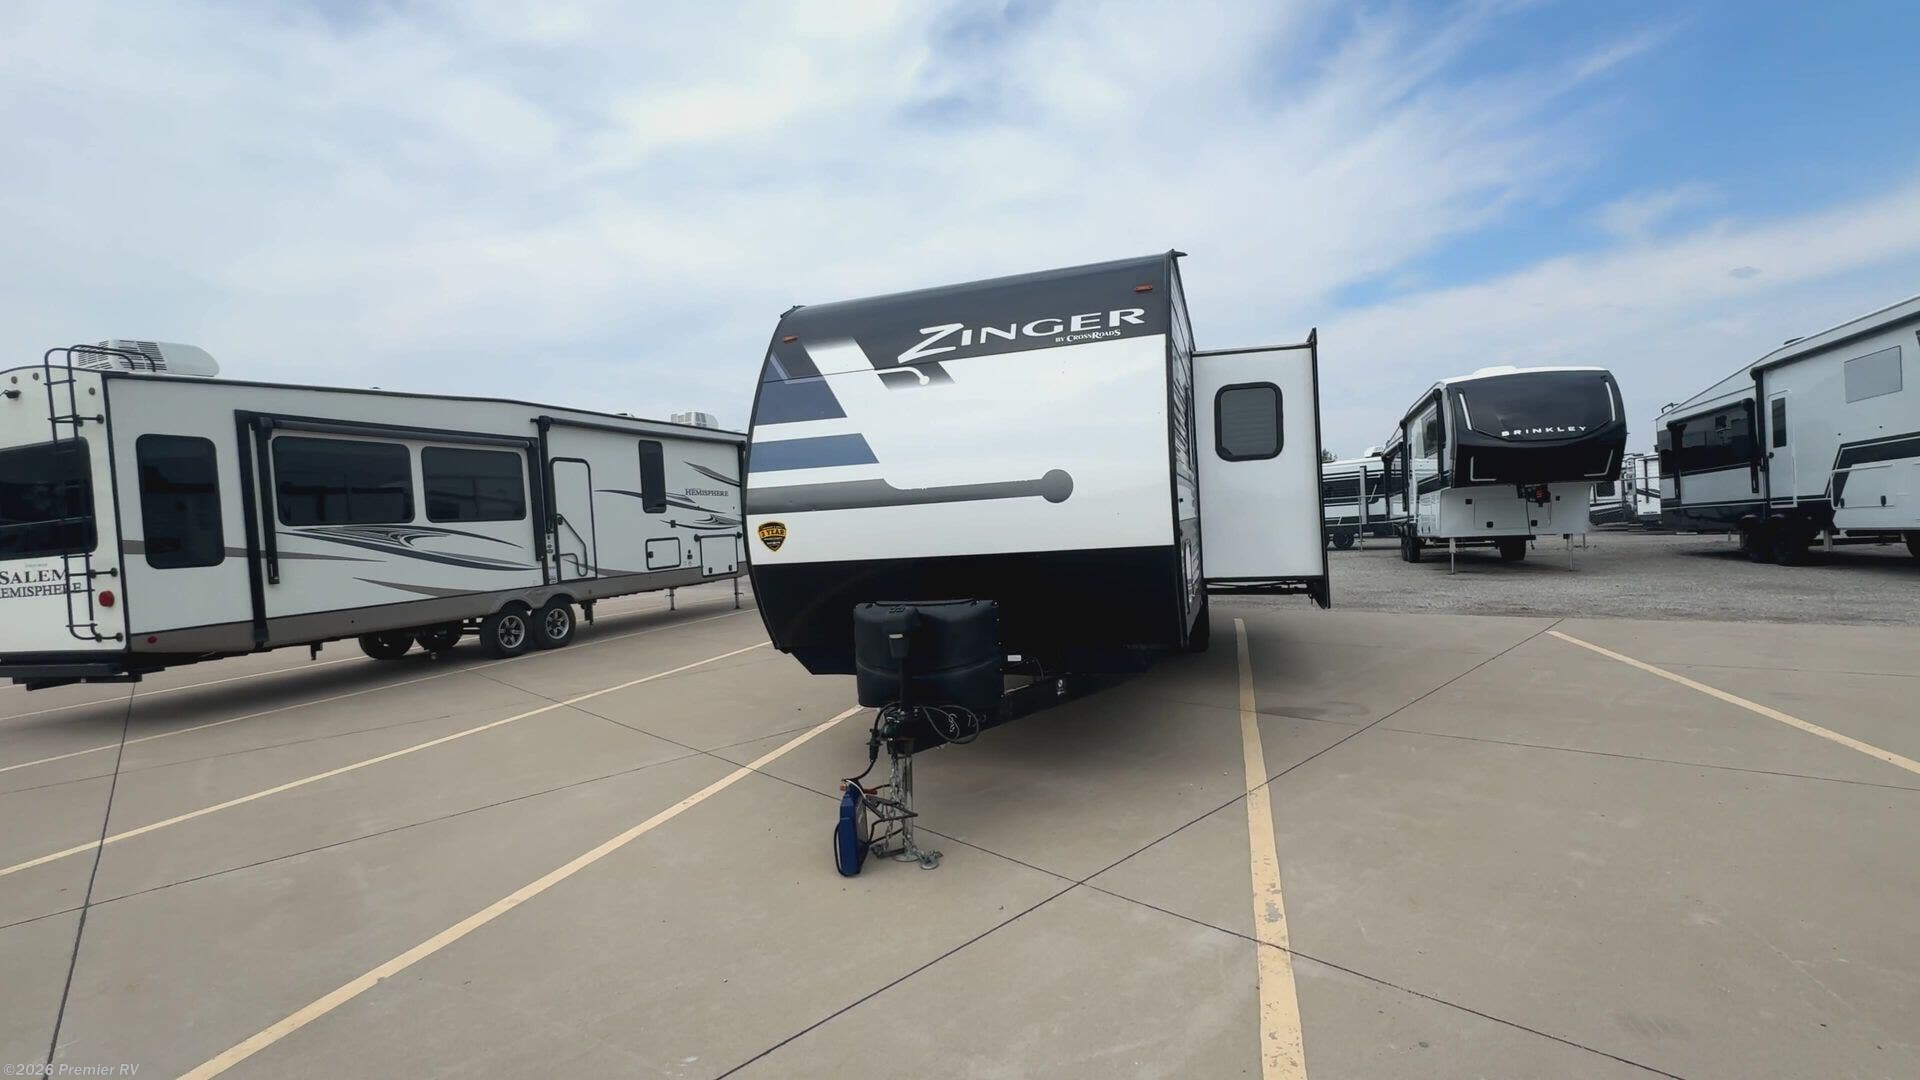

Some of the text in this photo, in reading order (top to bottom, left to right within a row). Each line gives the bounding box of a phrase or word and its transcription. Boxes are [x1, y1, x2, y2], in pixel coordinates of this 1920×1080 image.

[897, 307, 1145, 363] ZINGER
[1501, 426, 1586, 437] BRINKLEY
[685, 488, 729, 496] HEMISPHERE
[0, 569, 67, 585] SALEM
[0, 582, 81, 598] EMISPHEE
